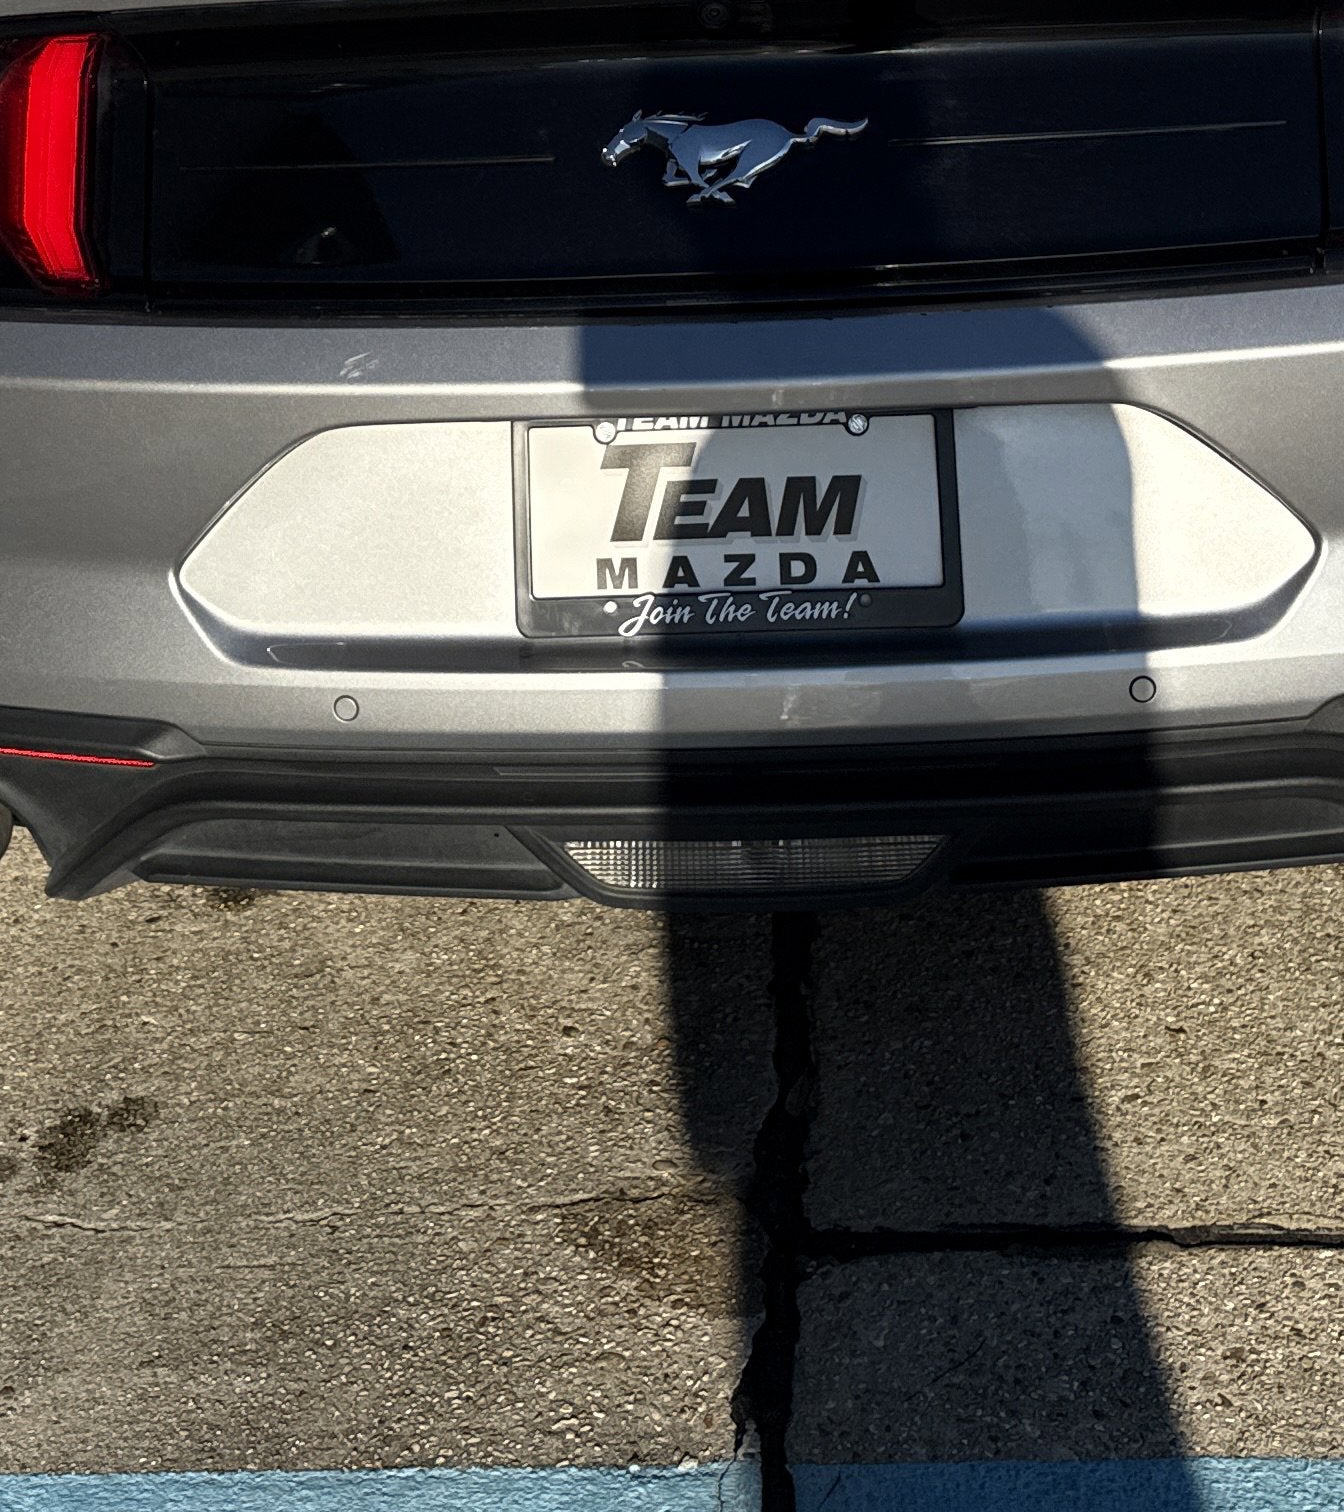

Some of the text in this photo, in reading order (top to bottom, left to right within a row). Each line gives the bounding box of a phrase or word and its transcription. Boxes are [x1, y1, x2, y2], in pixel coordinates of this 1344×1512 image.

[596, 550, 881, 591] MAZDA
[618, 590, 858, 637] Join The Team!
